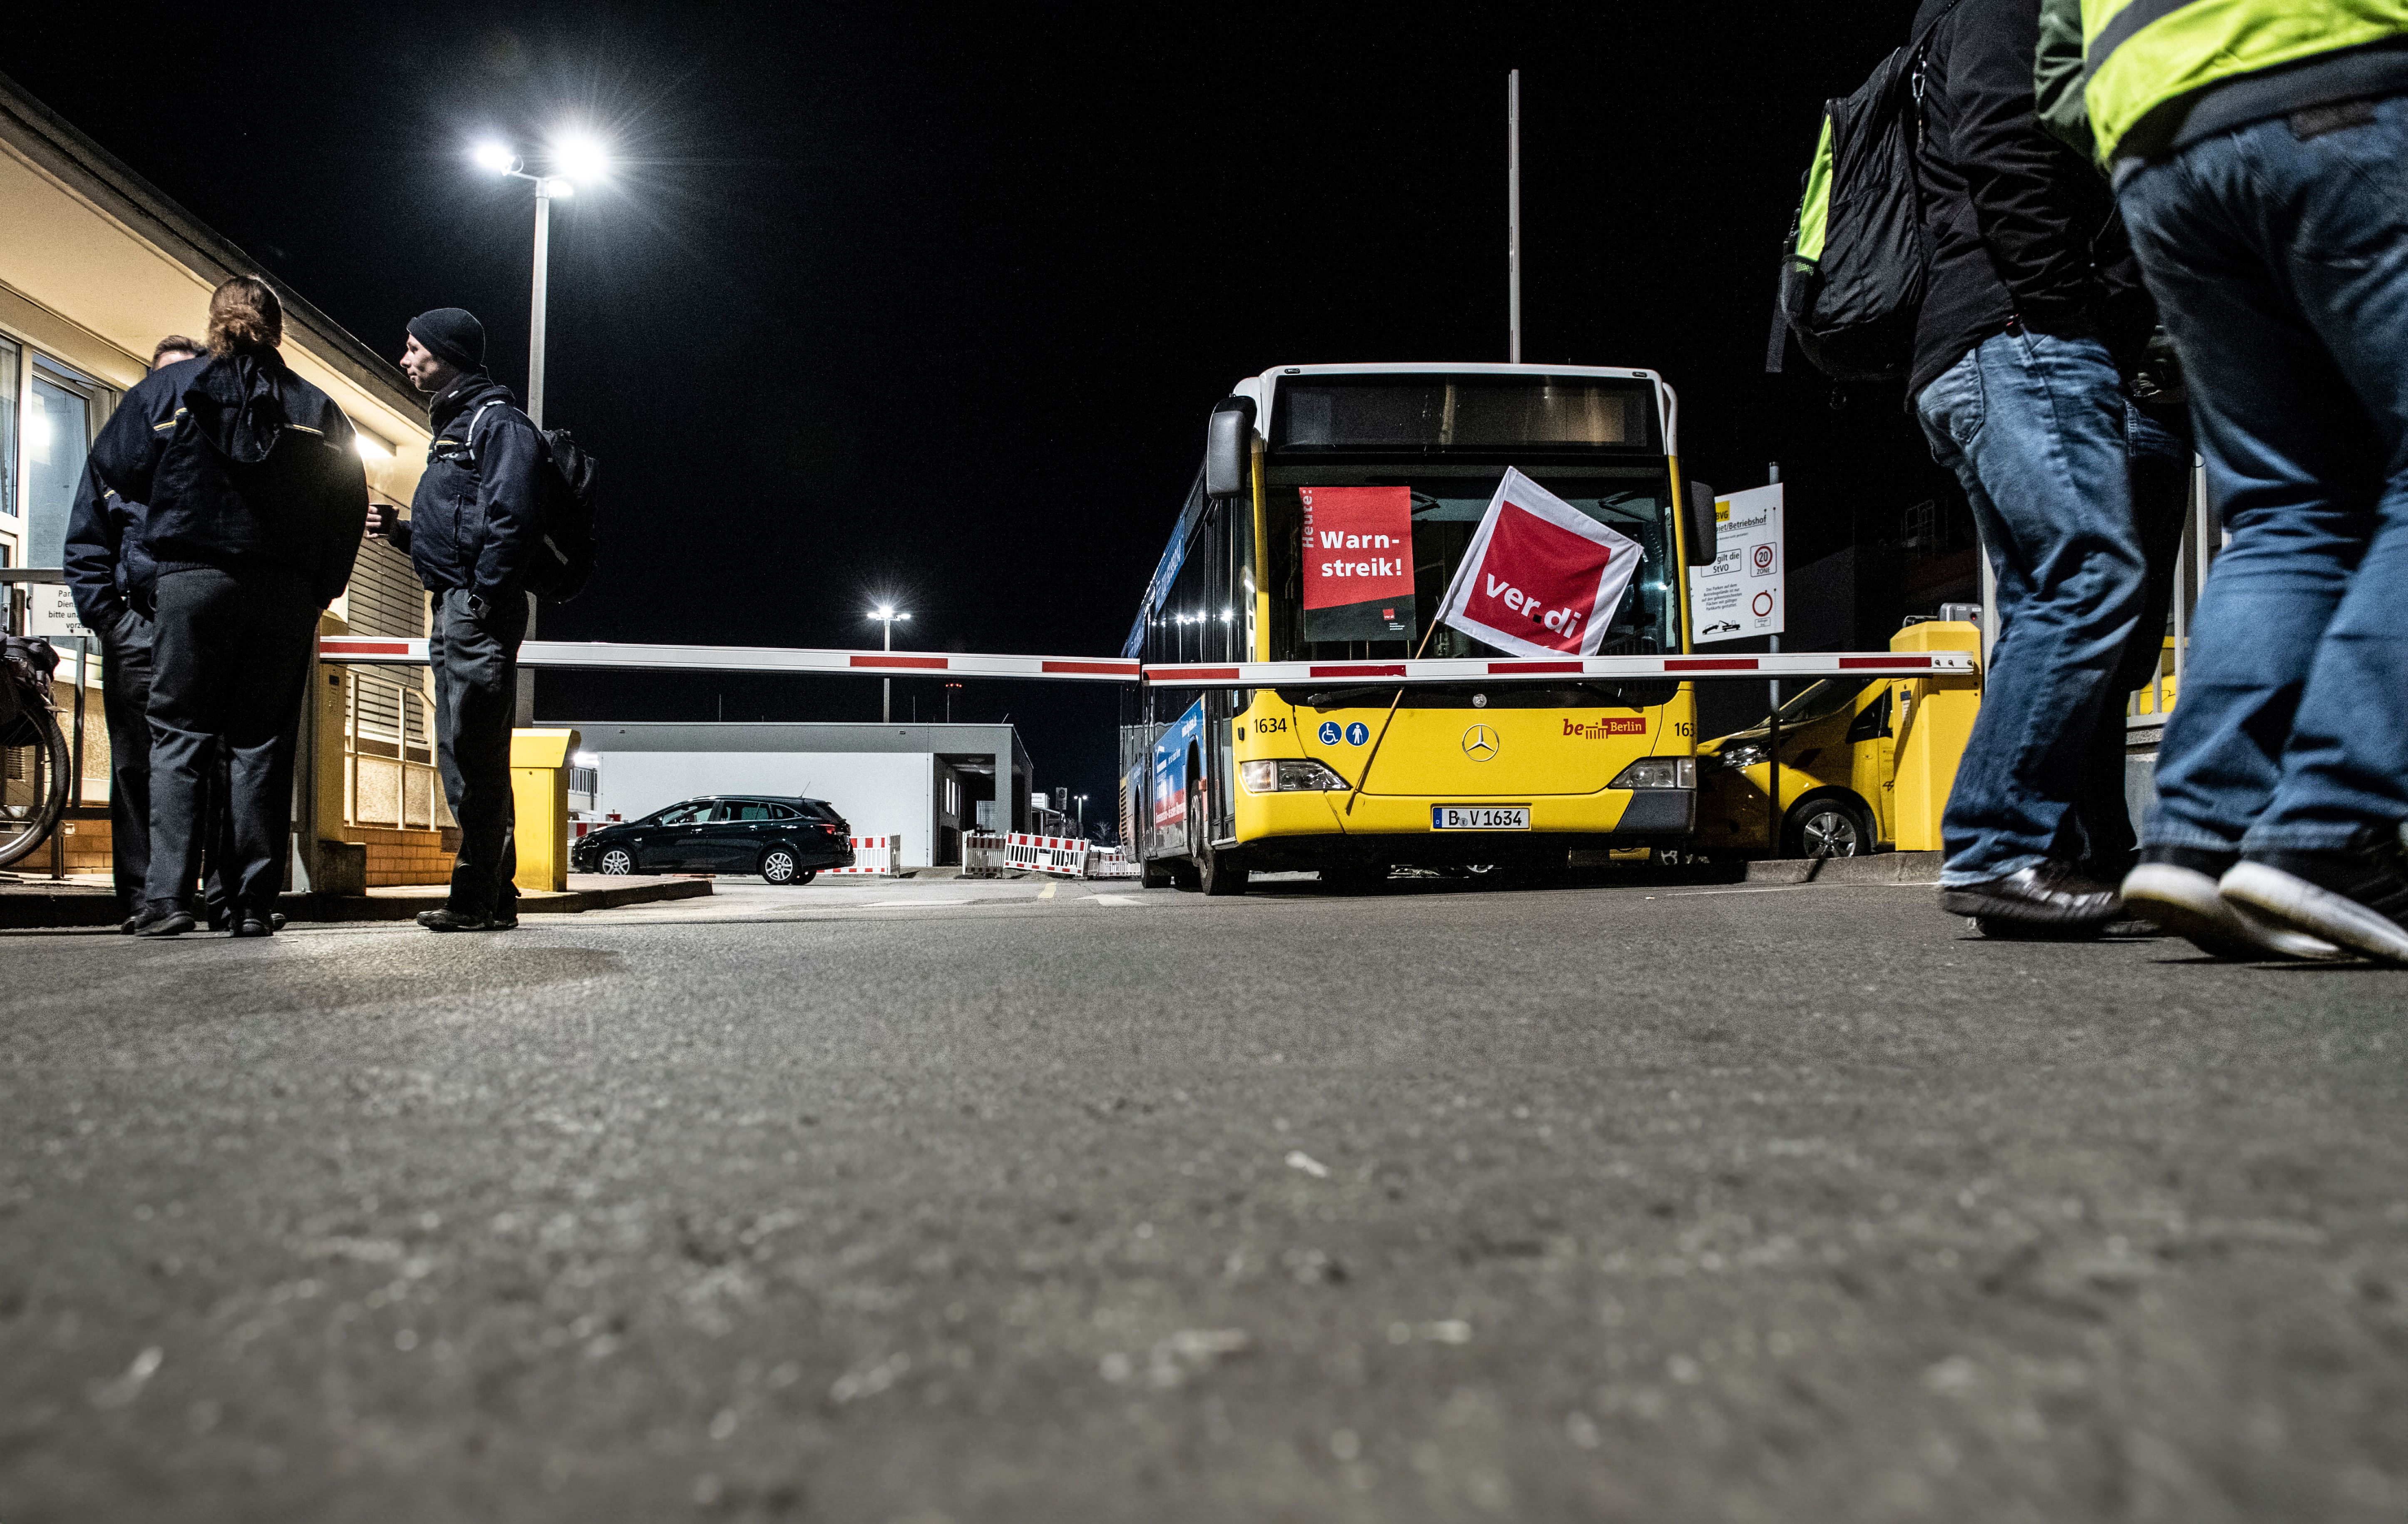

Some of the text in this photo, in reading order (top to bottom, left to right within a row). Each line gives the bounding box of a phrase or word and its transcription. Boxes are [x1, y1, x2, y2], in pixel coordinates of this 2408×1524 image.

[1302, 490, 1314, 547] Heute:
[1320, 531, 1399, 549] Warn-
[1717, 554, 1728, 564] gilt
[1759, 551, 1768, 562] 20
[1321, 557, 1402, 577] streik!
[1713, 564, 1729, 573] StVO
[1487, 573, 1581, 639] ver.di
[1254, 718, 1287, 733] 1634
[1563, 718, 1642, 735] be Berlin
[1449, 810, 1522, 826] B V 1634
